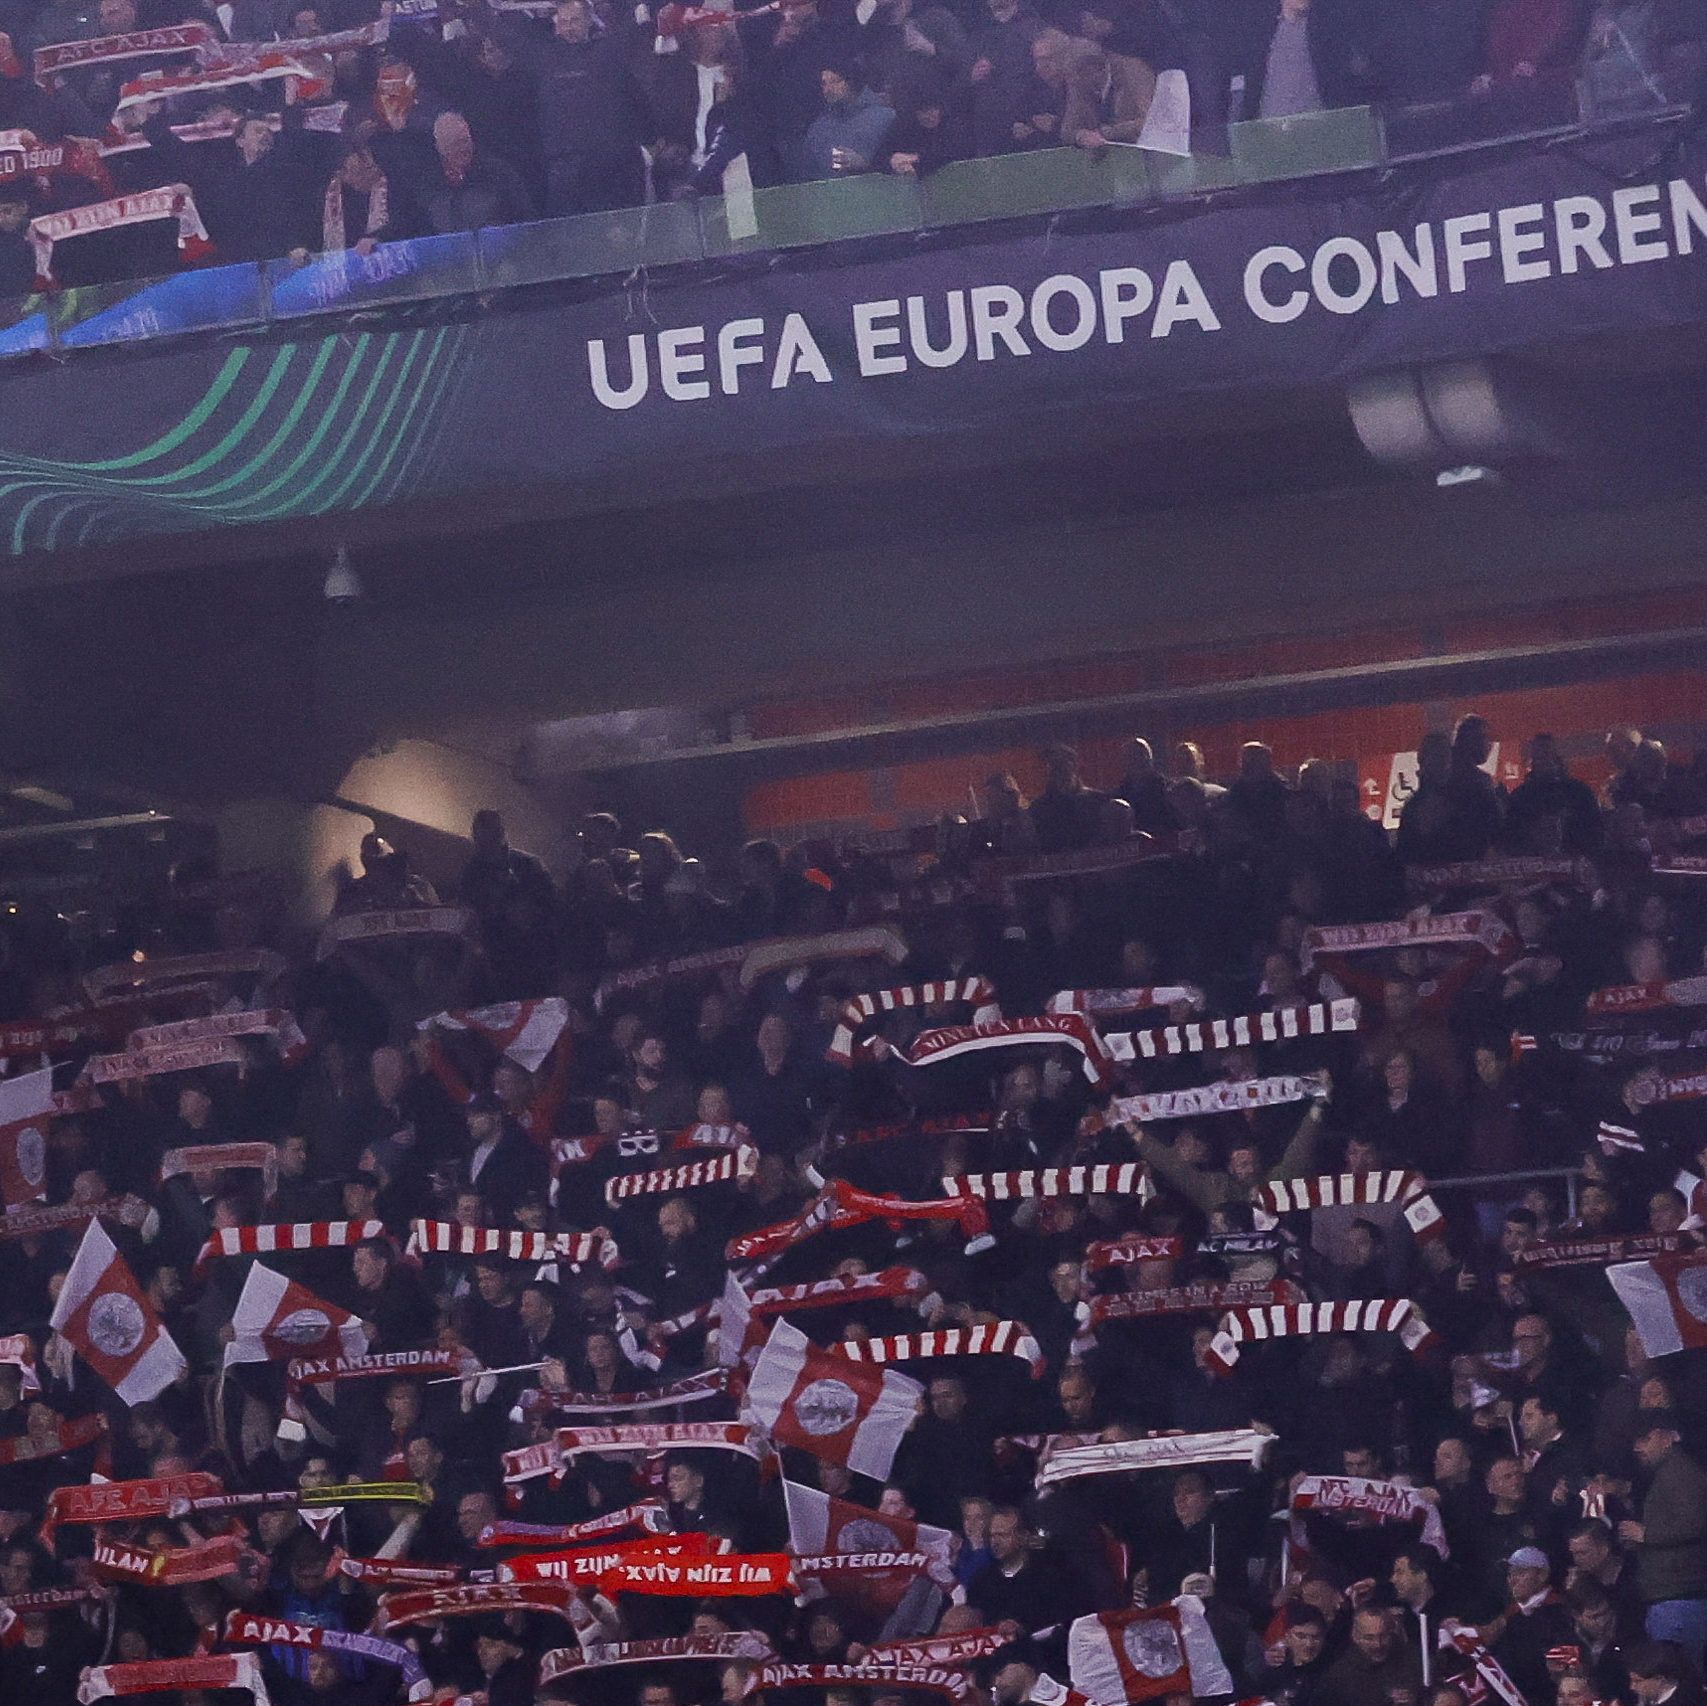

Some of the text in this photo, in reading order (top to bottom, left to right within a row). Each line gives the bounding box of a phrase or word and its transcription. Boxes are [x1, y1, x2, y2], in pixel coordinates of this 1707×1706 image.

[587, 313, 834, 410] UEFA
[852, 259, 1222, 377] EUROPA
[1110, 1241, 1170, 1263] AJAX
[335, 1350, 450, 1372] AMSTERDAM
[687, 1565, 732, 1583] ZIJN
[738, 1564, 772, 1582] WIJ
[243, 1621, 312, 1644] AJAX
